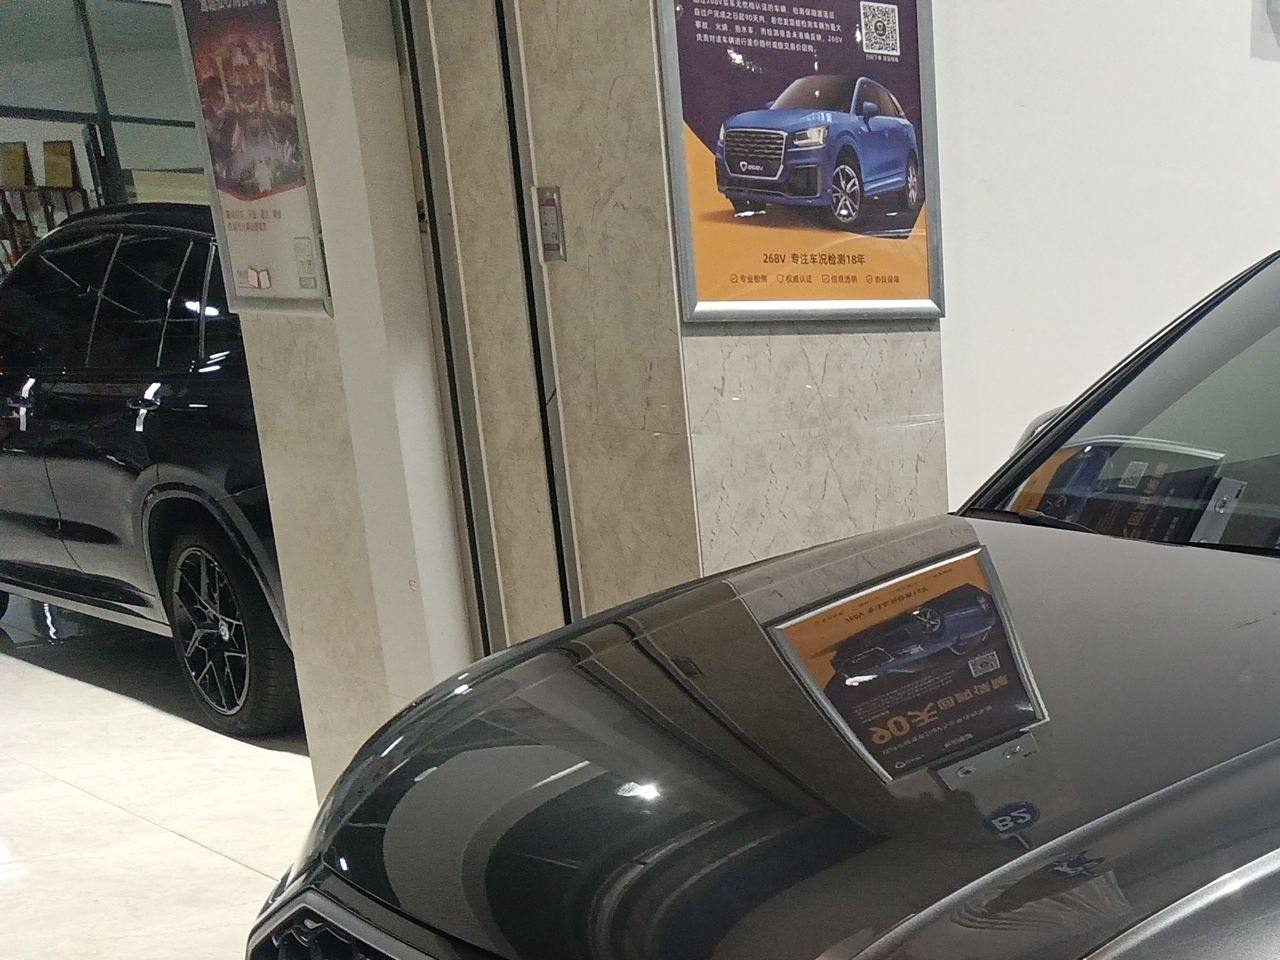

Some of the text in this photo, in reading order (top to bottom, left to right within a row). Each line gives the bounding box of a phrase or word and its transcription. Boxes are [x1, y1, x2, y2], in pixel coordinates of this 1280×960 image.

[763, 253, 866, 265] 268V 专注车况检测18年
